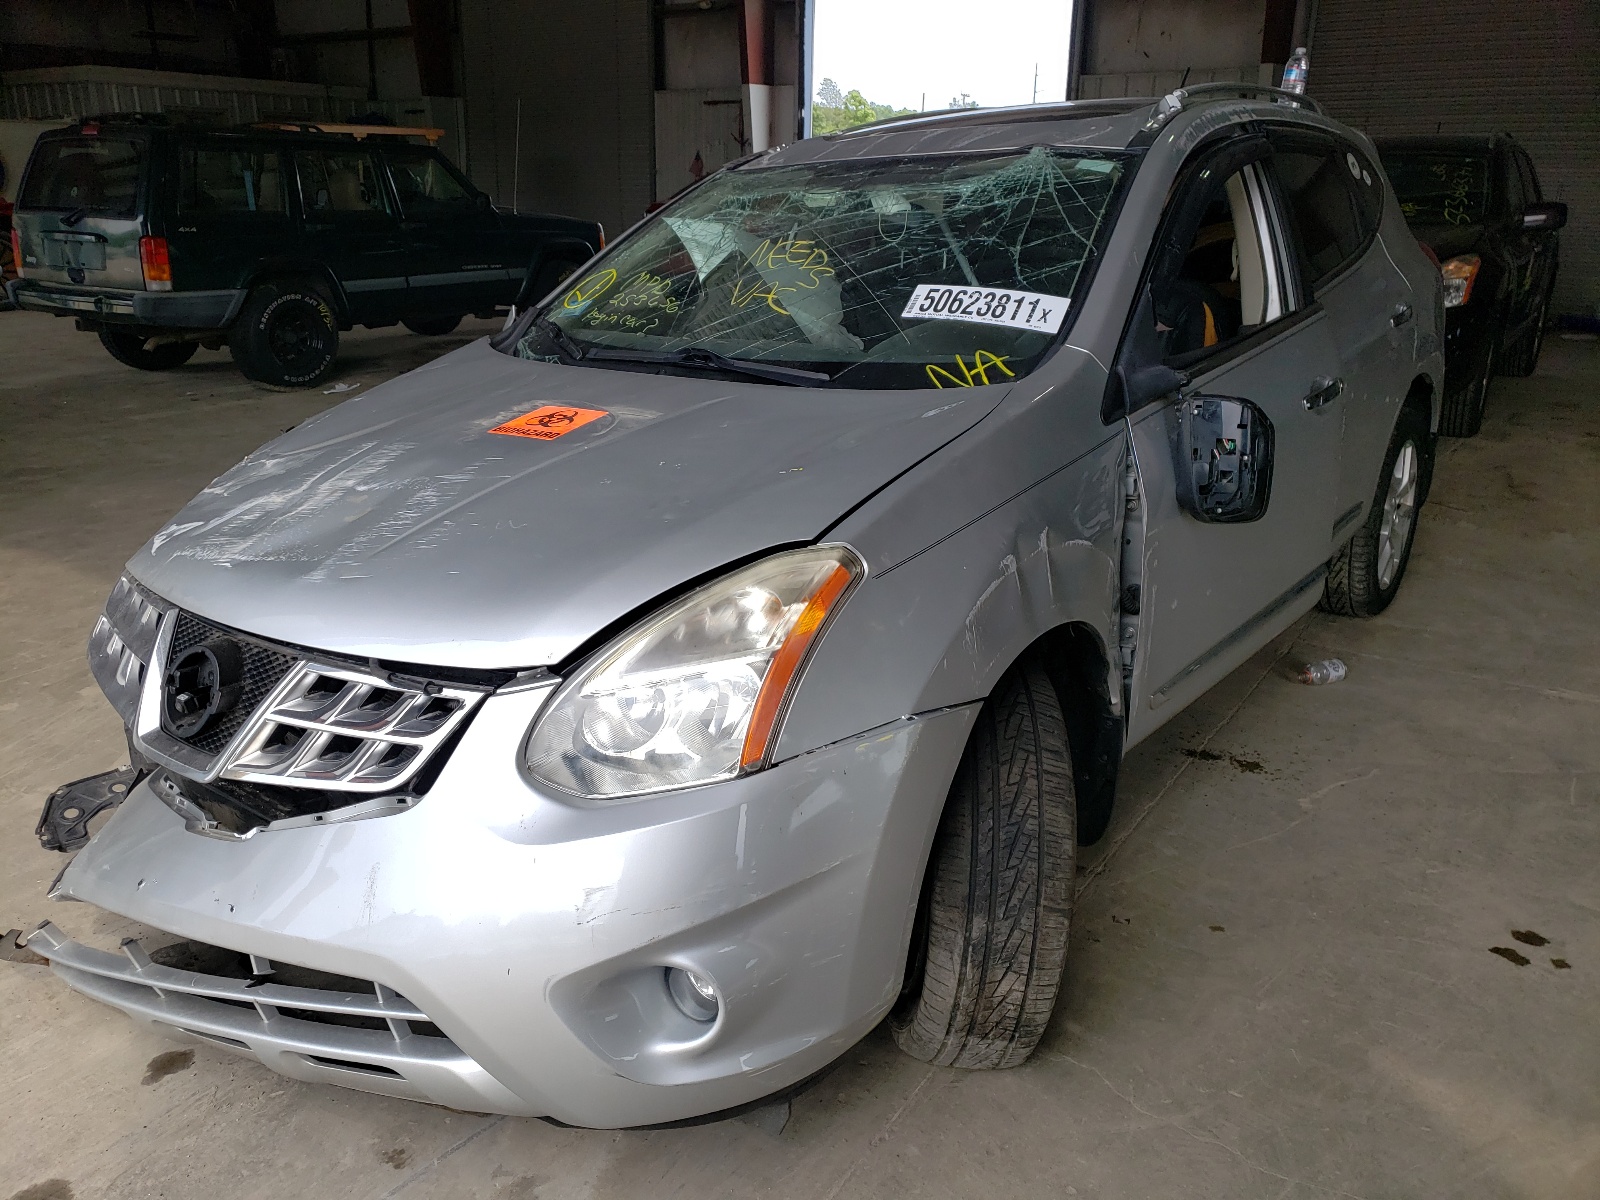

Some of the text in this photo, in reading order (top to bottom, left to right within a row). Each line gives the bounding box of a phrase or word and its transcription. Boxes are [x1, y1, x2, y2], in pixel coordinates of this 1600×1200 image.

[743, 237, 835, 289] NEEDS
[730, 279, 797, 315] VAC
[926, 350, 1015, 389] NA
